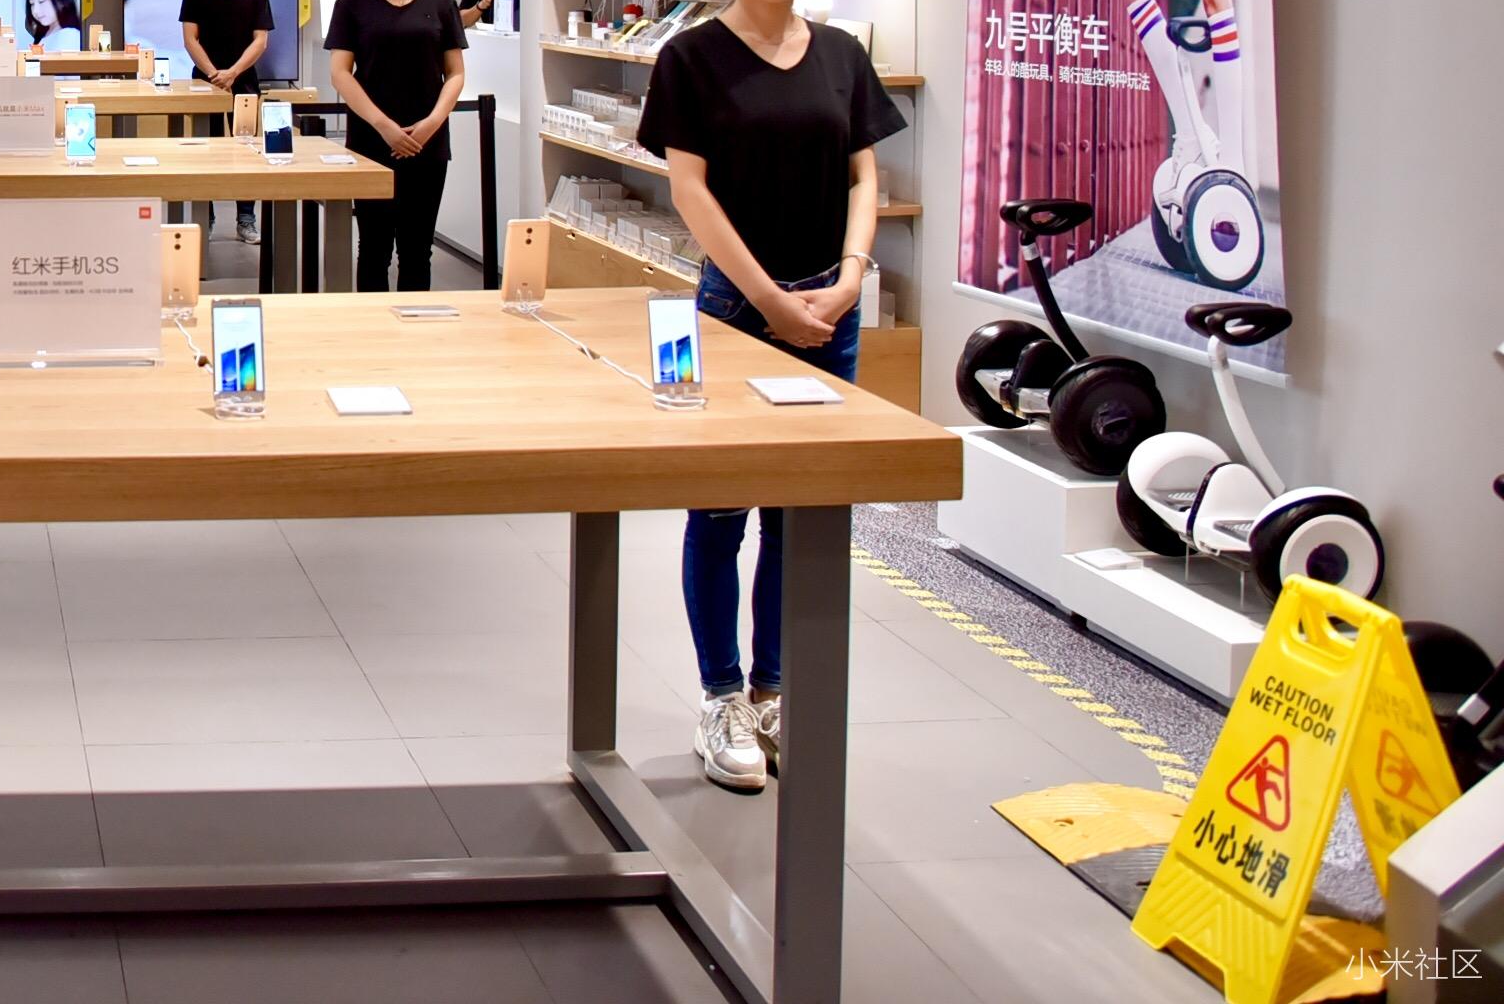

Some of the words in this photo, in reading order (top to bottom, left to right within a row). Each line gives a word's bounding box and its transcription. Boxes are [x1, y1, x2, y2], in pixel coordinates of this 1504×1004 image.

[984, 8, 1110, 59] 九号平衡车
[11, 255, 120, 277] 红米手机3S
[1249, 687, 1283, 717] WET
[1282, 707, 1338, 747] FLOOR
[1265, 676, 1335, 722] CAUTION
[1193, 809, 1291, 899] 小心地滑
